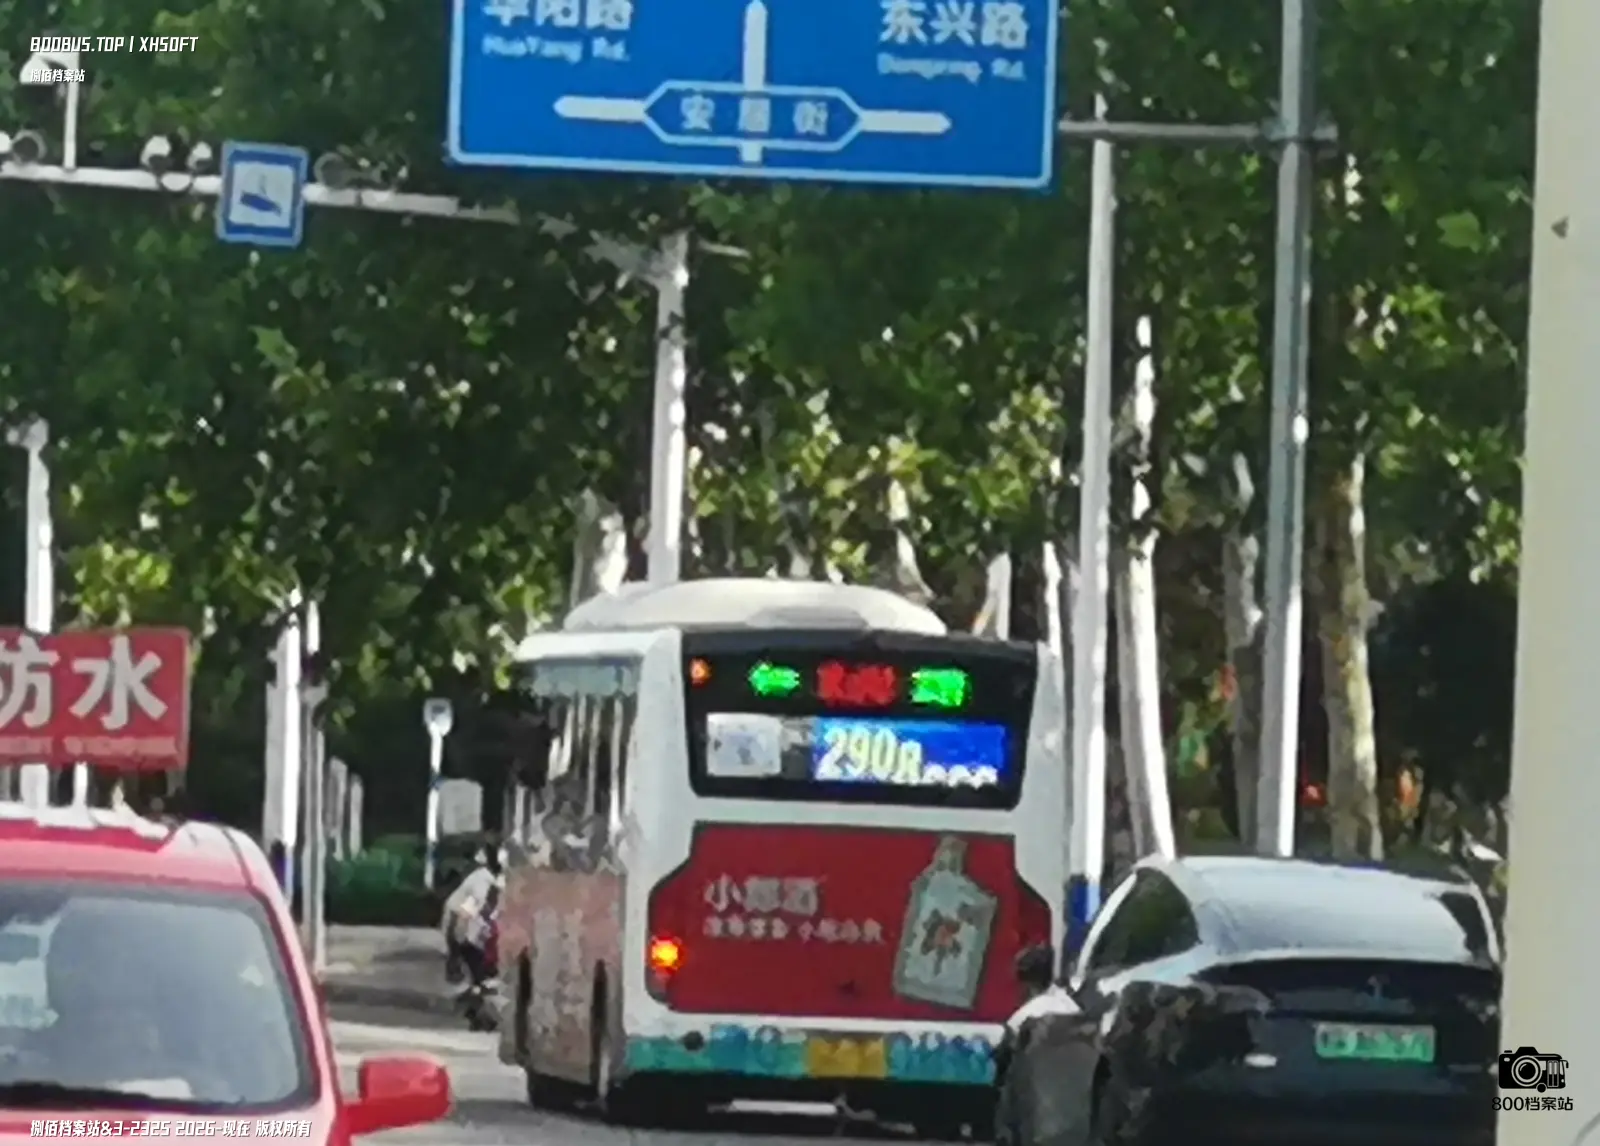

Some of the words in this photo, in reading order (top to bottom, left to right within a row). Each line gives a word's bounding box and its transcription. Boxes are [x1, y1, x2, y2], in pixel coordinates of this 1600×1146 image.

[879, 0, 1029, 49] 东兴路
[0, 634, 168, 731] 防水
